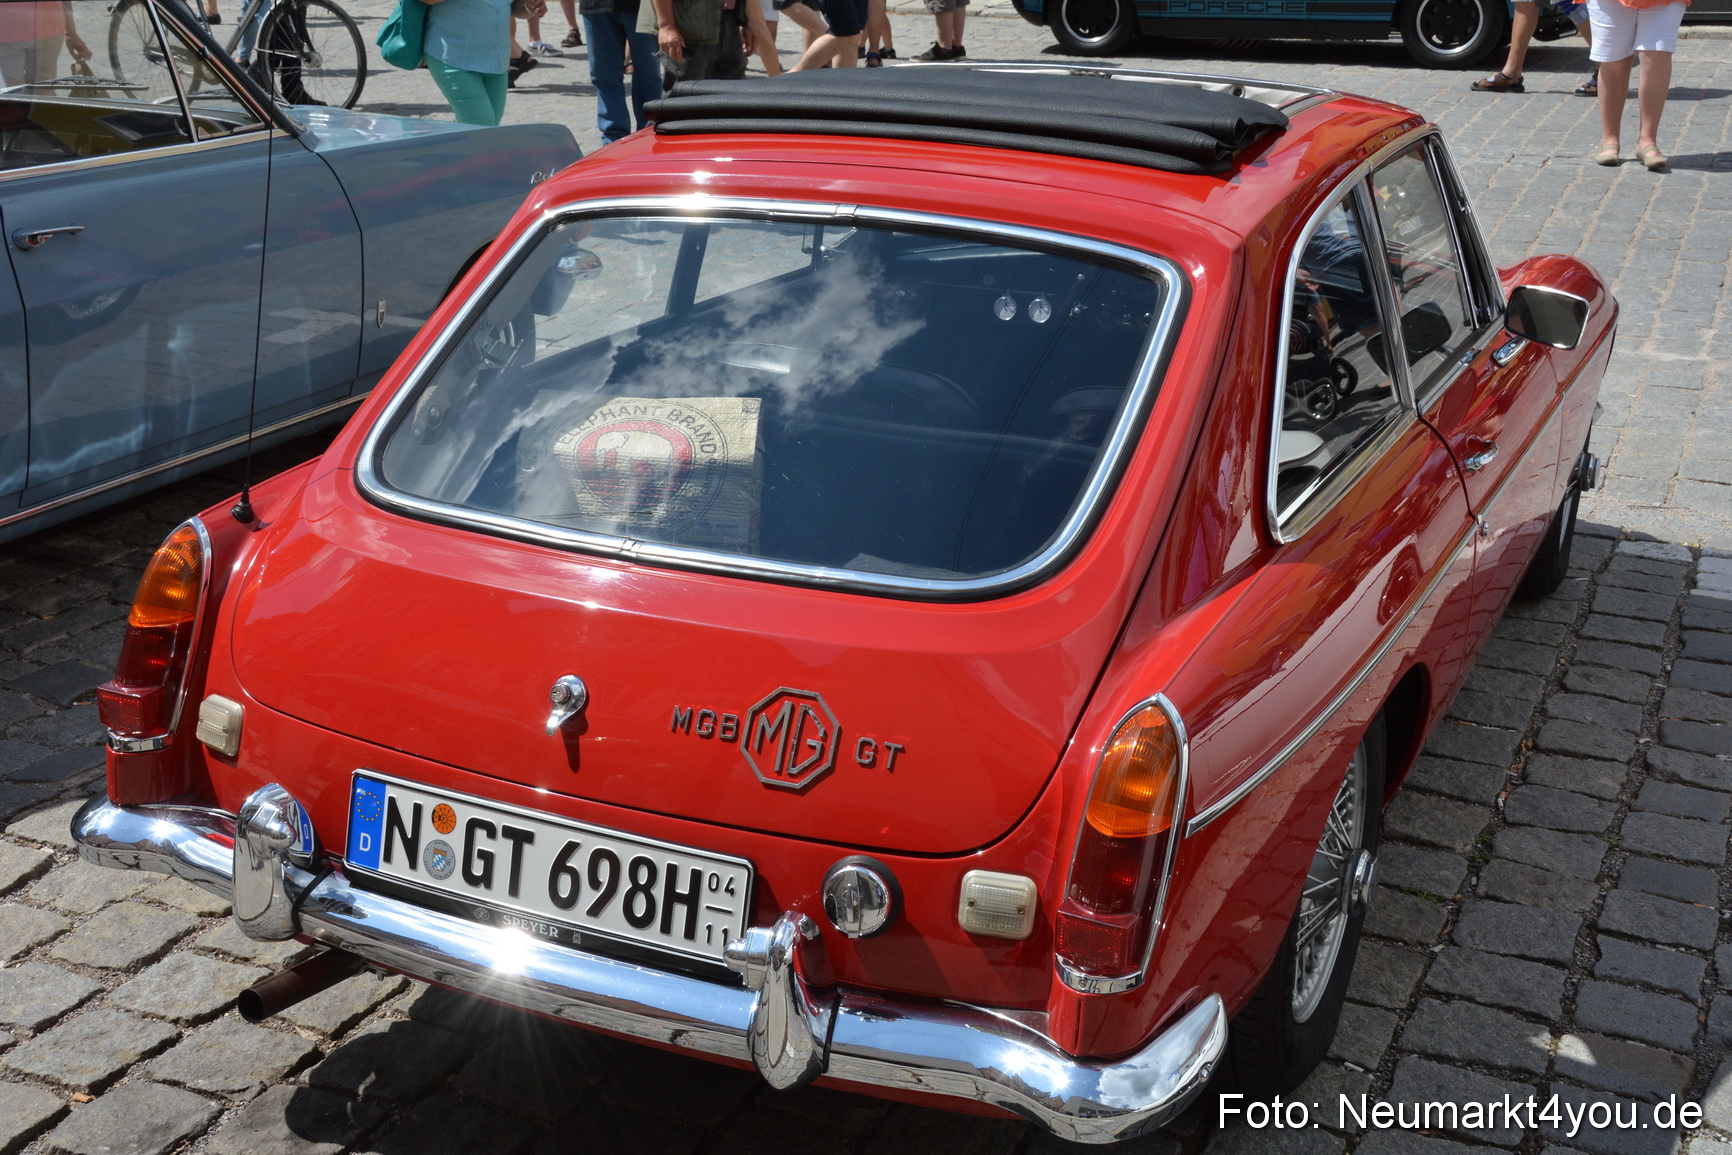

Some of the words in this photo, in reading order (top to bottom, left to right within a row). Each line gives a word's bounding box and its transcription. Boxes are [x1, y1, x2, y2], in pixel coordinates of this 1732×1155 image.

[1168, 1, 1305, 13] PORSCHE
[558, 404, 664, 446] ELEPHANT
[666, 409, 717, 455] BRAND
[670, 704, 739, 740] MGB
[754, 701, 825, 775] MG
[855, 736, 903, 769] GT
[359, 832, 371, 852] D
[383, 795, 422, 870] N
[462, 816, 534, 898] GT
[547, 839, 702, 941] 698H
[707, 872, 735, 897] 04
[502, 914, 559, 938] SPEYER
[705, 923, 728, 947] 11
